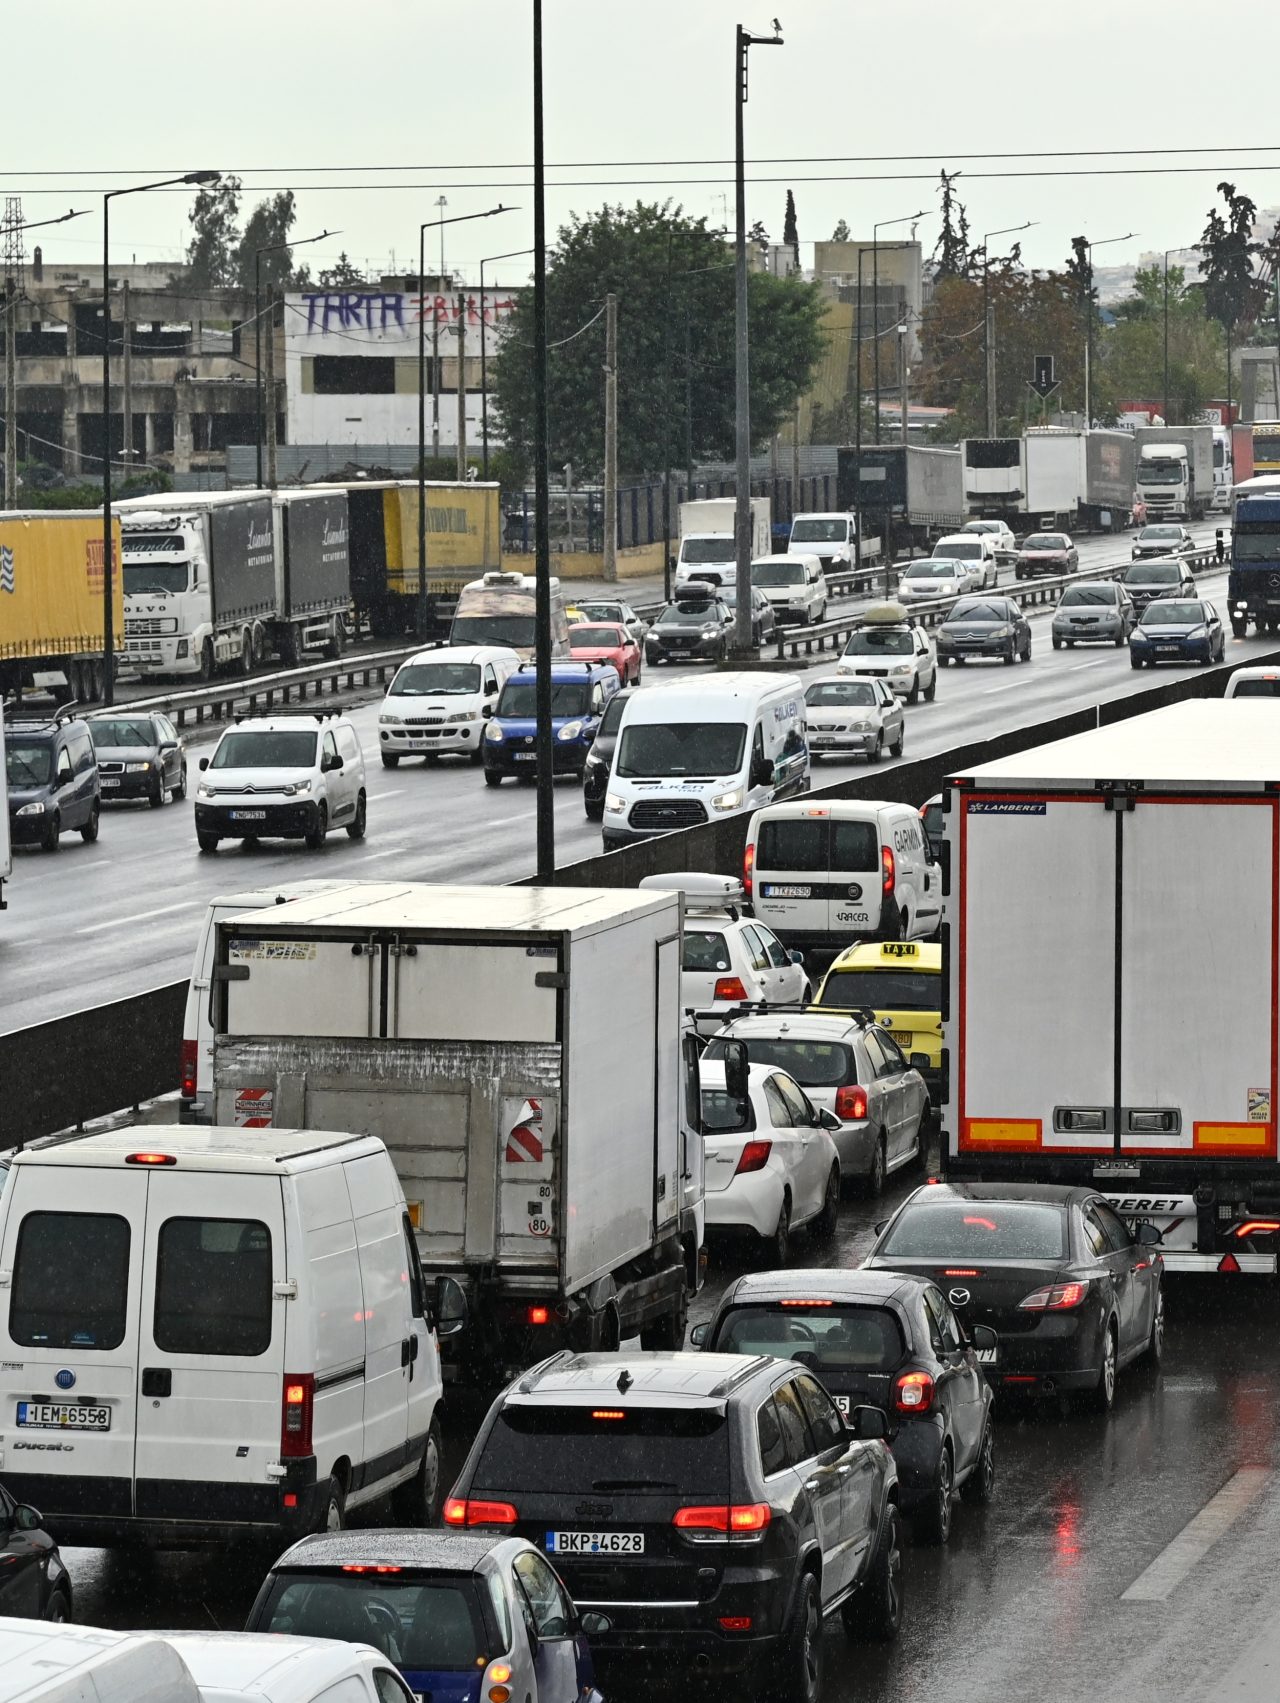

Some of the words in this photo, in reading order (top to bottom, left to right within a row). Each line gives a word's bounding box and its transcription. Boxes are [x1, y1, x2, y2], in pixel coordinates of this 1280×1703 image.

[123, 538, 176, 551] osanda
[124, 605, 167, 613] OLVO
[984, 803, 1045, 811] LAMBERET
[894, 829, 923, 853] GARMIN
[886, 945, 913, 953] TAXI
[539, 1186, 551, 1197] 80
[1107, 1198, 1183, 1211] BERET
[532, 1220, 547, 1231] 80
[13, 1441, 74, 1452] Ducato
